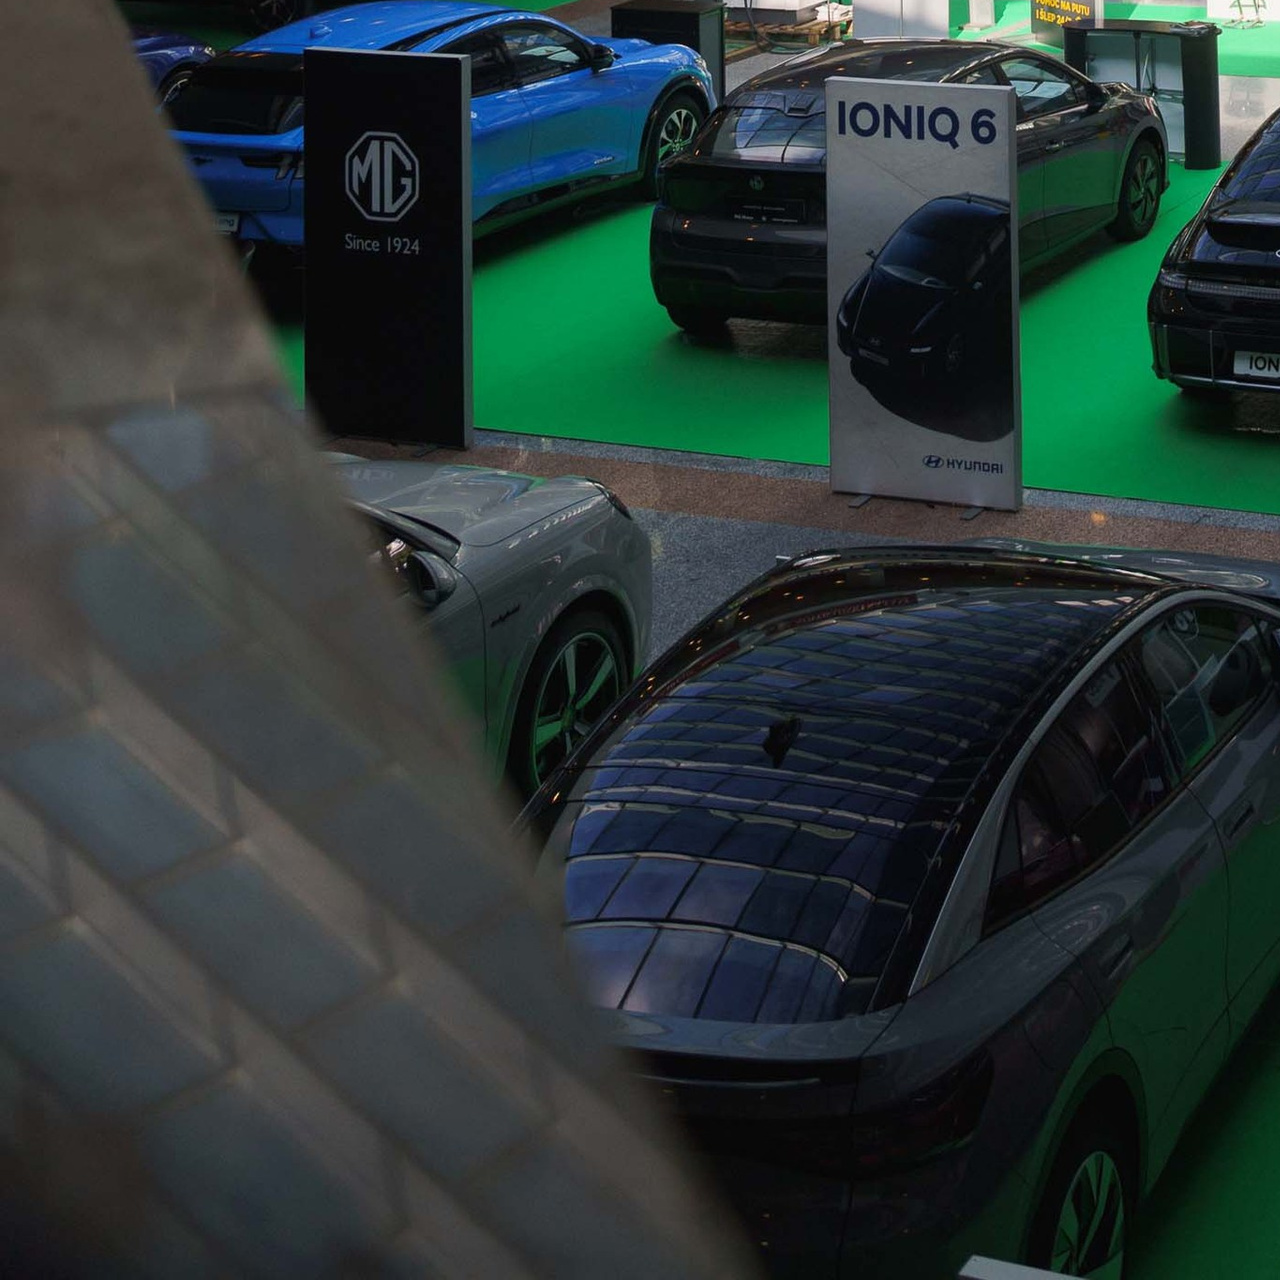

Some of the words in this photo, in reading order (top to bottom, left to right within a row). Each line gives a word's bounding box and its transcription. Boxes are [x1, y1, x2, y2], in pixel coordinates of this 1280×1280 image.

[1060, 0, 1071, 11] NA
[1071, 2, 1090, 17] PUTU
[838, 100, 960, 150] IONIQ
[970, 108, 997, 145] 6
[352, 139, 413, 214] MG
[345, 233, 380, 252] Since
[387, 236, 420, 255] 1924
[947, 458, 1003, 474] HYUNDAI
